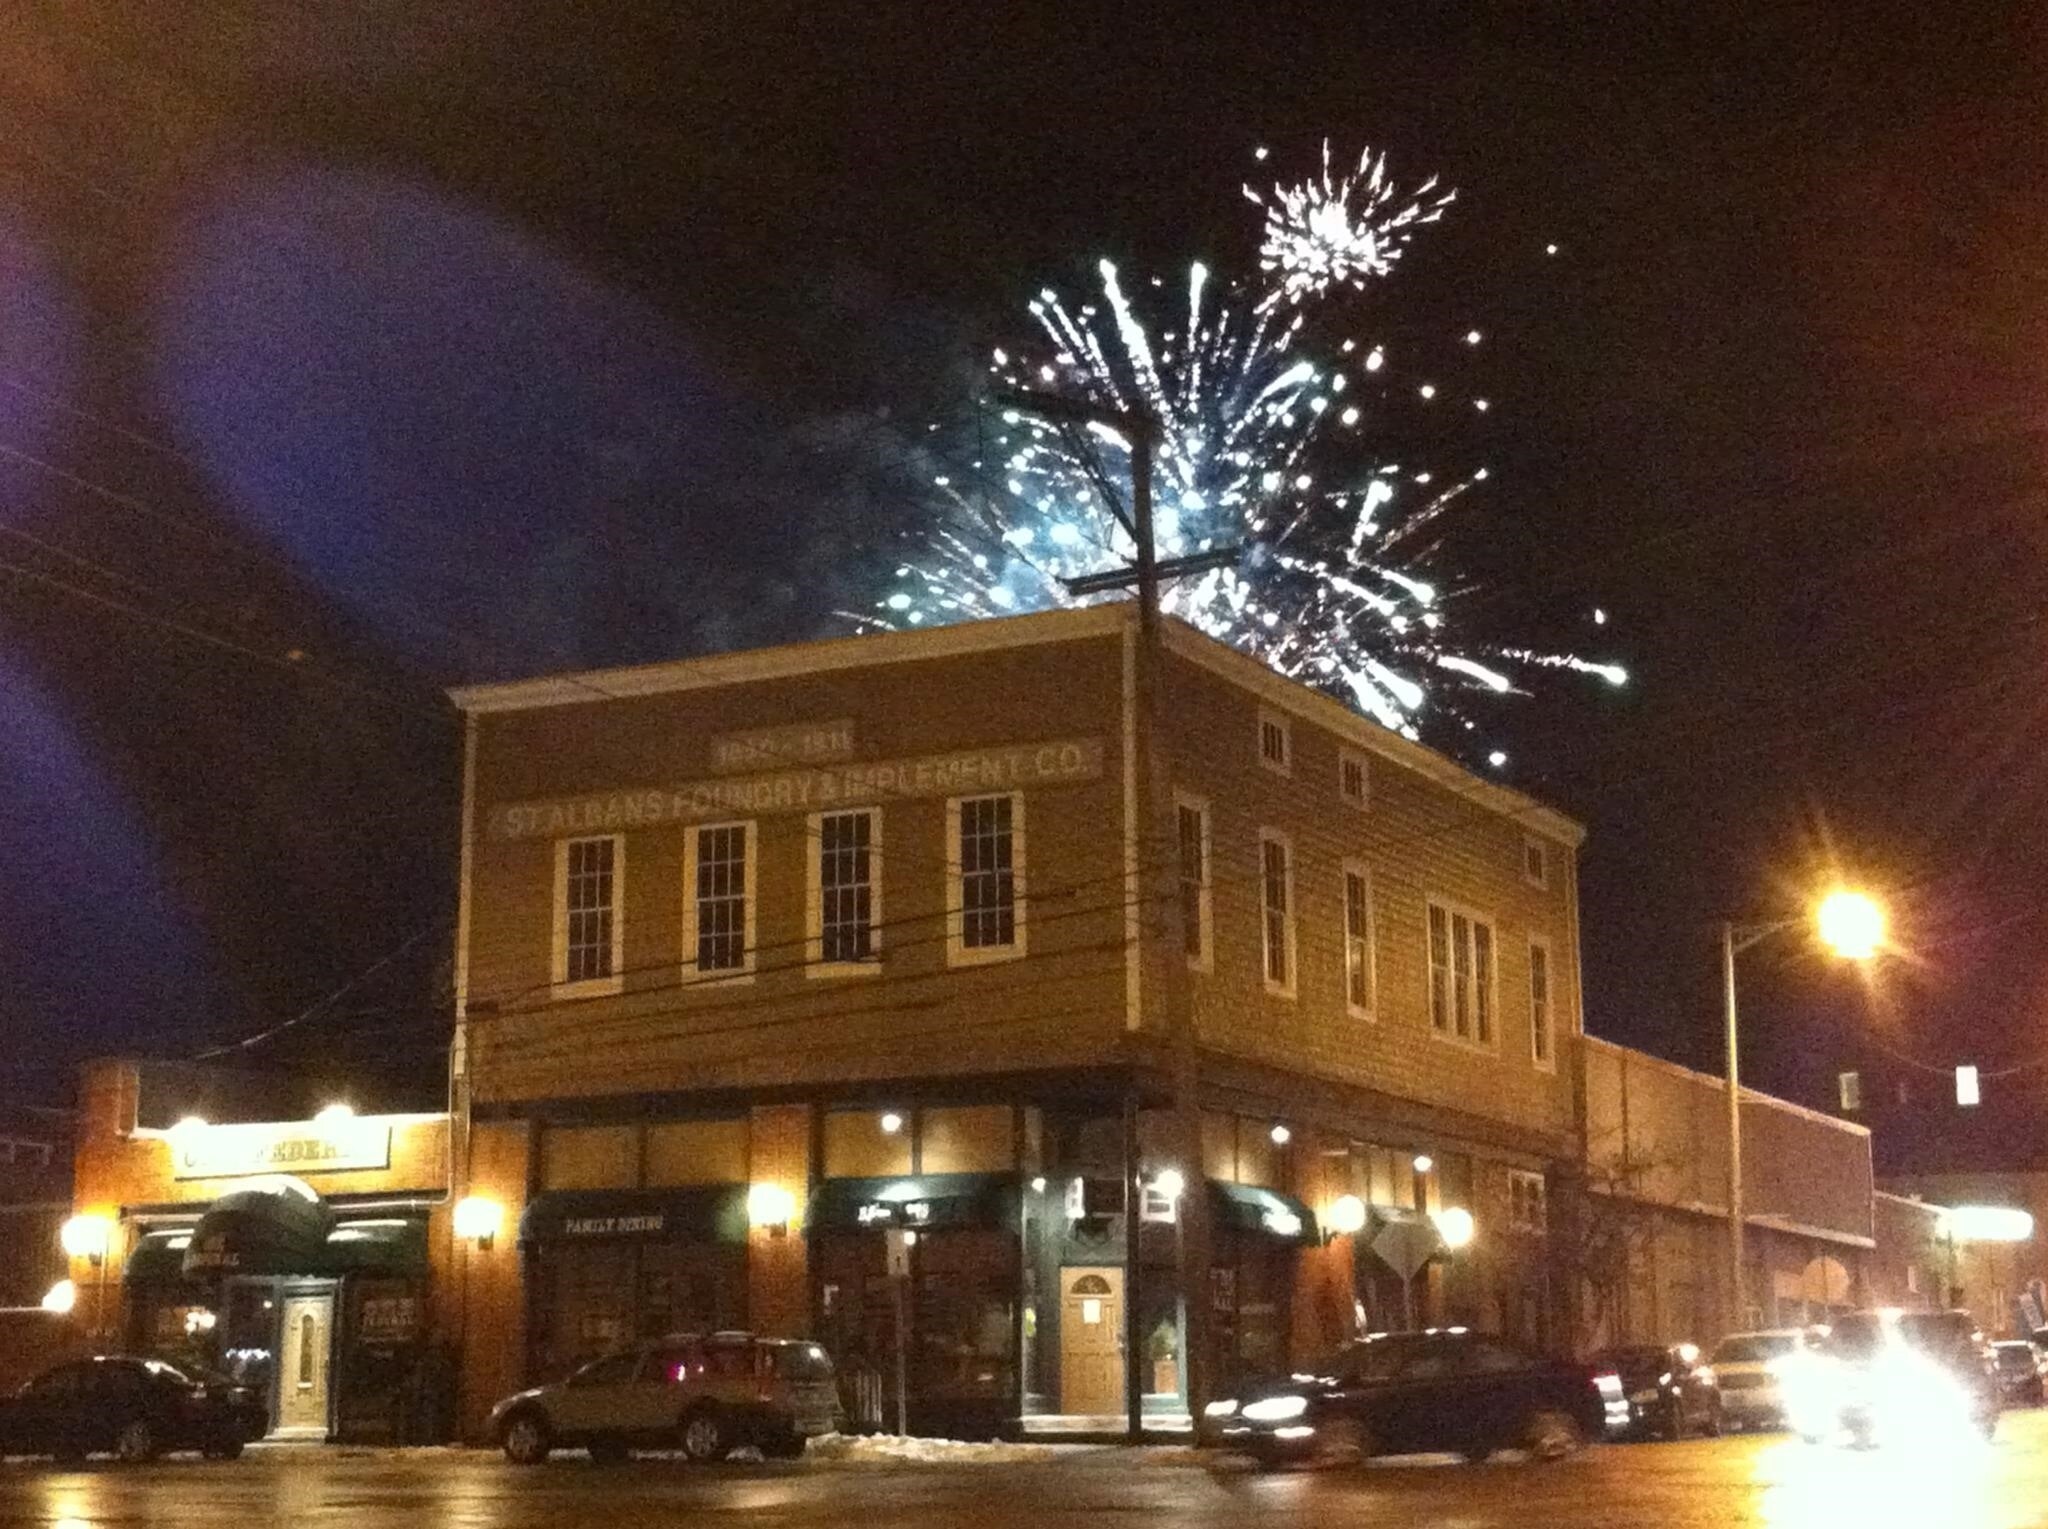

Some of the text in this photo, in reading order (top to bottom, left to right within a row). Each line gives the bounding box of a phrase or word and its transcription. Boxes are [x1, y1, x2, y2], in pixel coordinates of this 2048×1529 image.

[550, 791, 663, 831] ALBANS
[673, 775, 813, 818] FOUNDRY
[820, 771, 837, 795] &
[843, 752, 1020, 799] IMPLEMENT
[566, 1215, 664, 1233] FAMILY DINING
